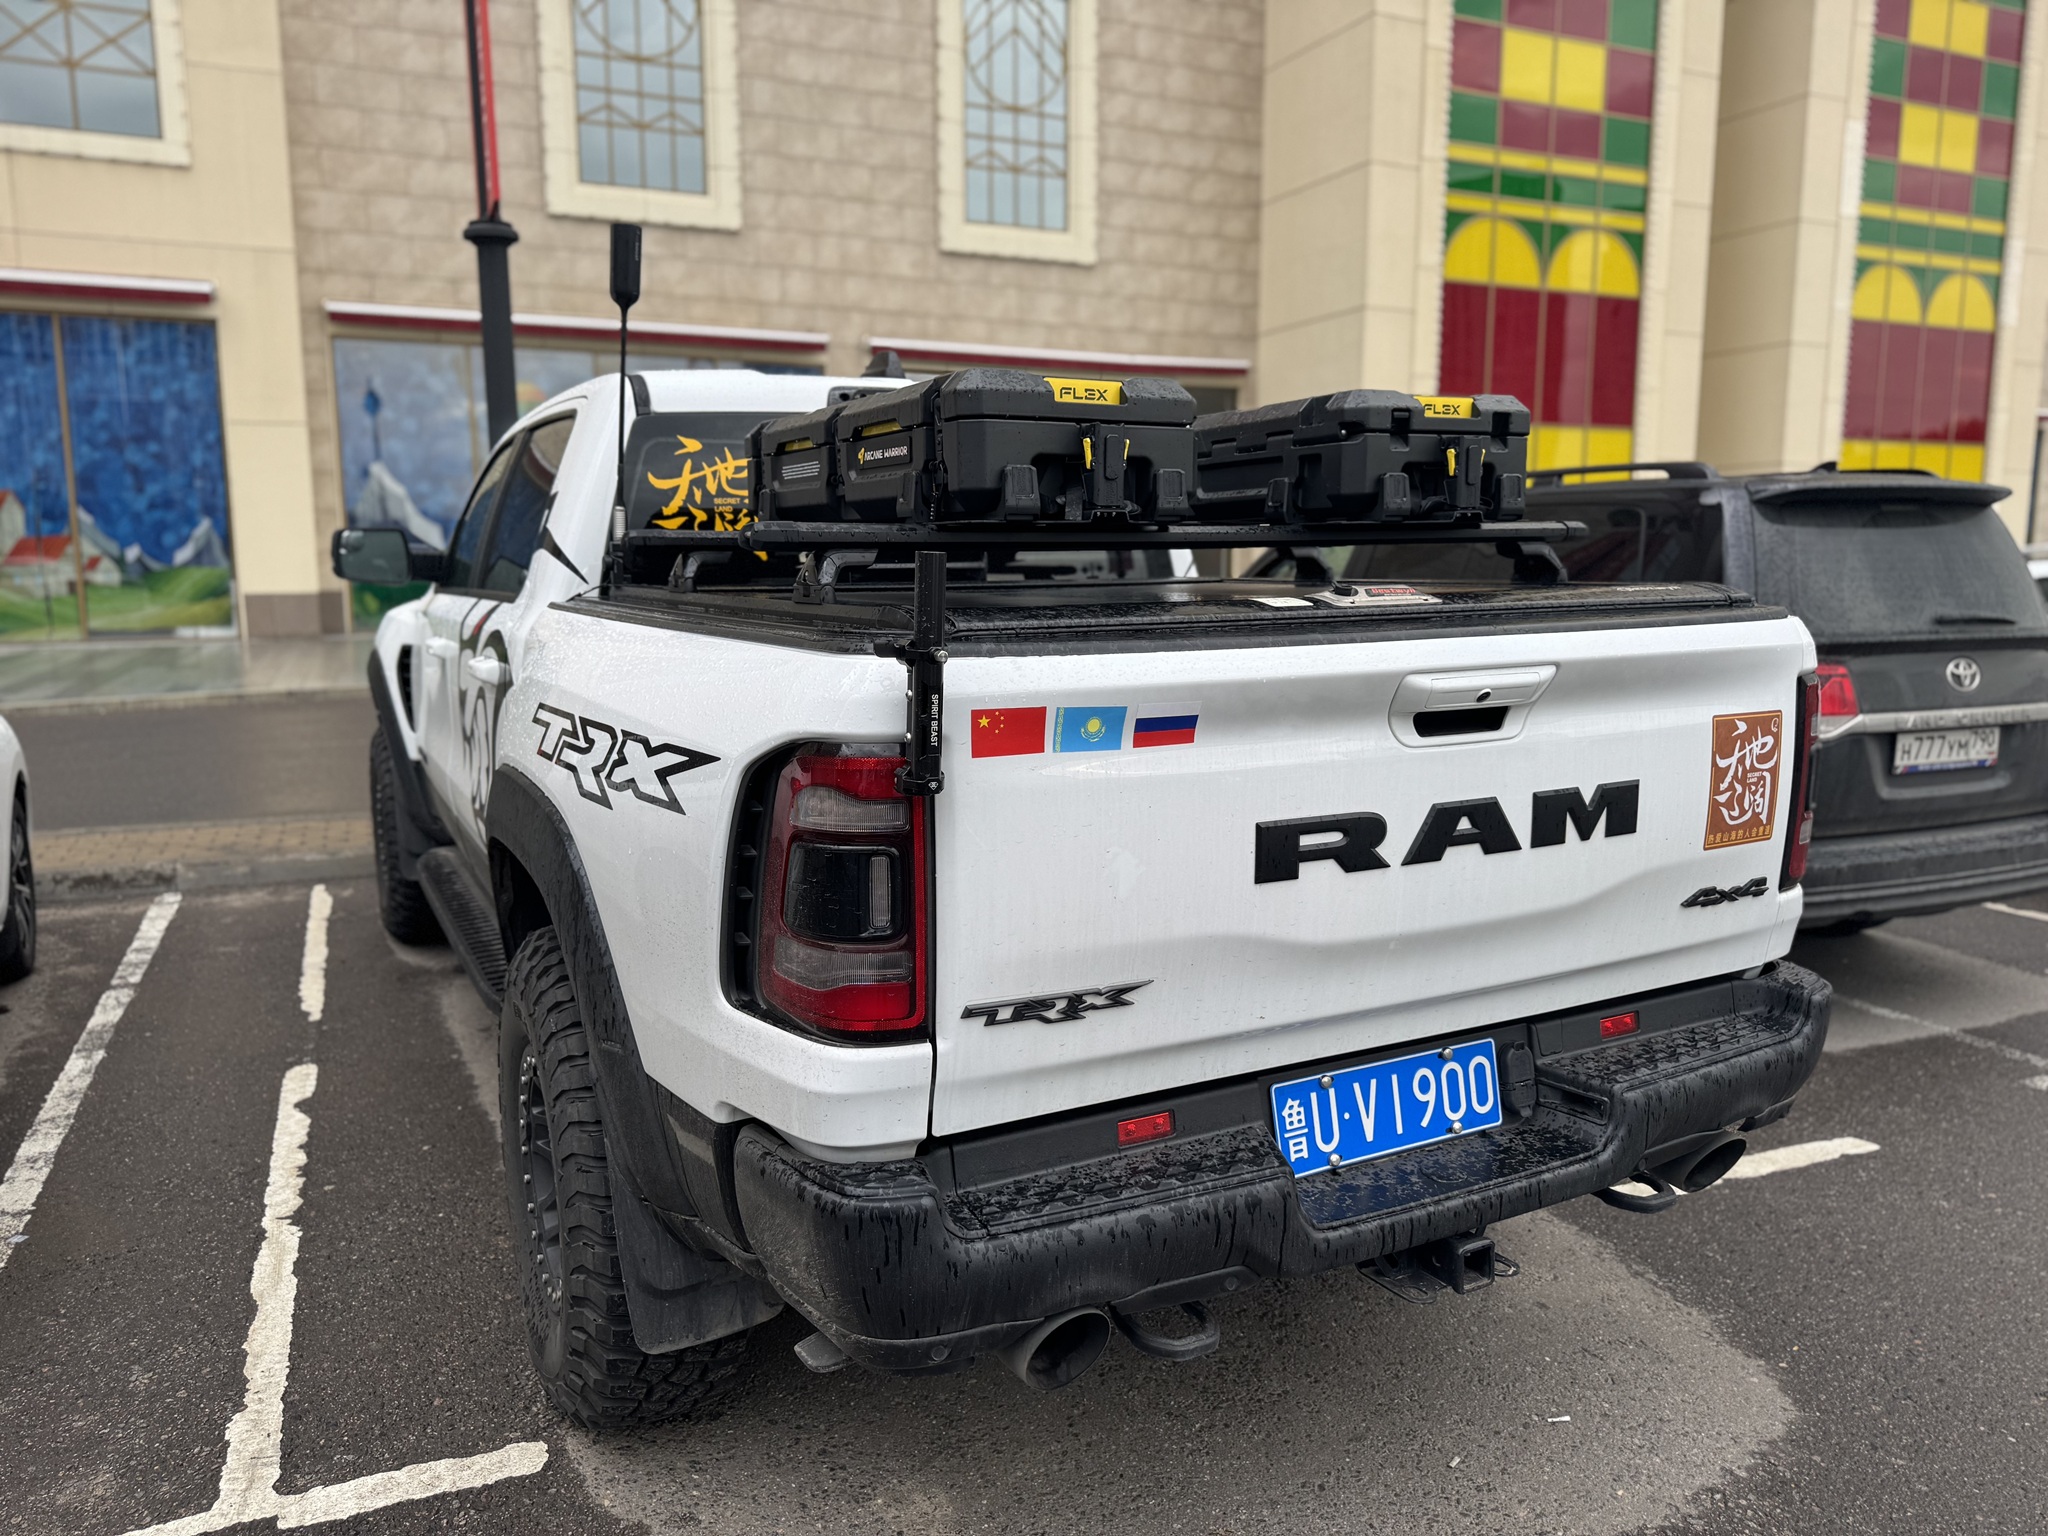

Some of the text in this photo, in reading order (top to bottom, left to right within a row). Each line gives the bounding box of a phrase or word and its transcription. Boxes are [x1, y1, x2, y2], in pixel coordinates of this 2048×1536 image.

[1060, 386, 1108, 402] FLEX
[1424, 403, 1461, 416] FLEX
[864, 445, 908, 461] ARCANE WARRIOR
[713, 497, 741, 505] SECRET
[930, 693, 939, 747] SPIRIT BEAST
[531, 701, 722, 816] TRX
[1254, 779, 1640, 884] RAM
[960, 978, 1155, 1027] TRX
